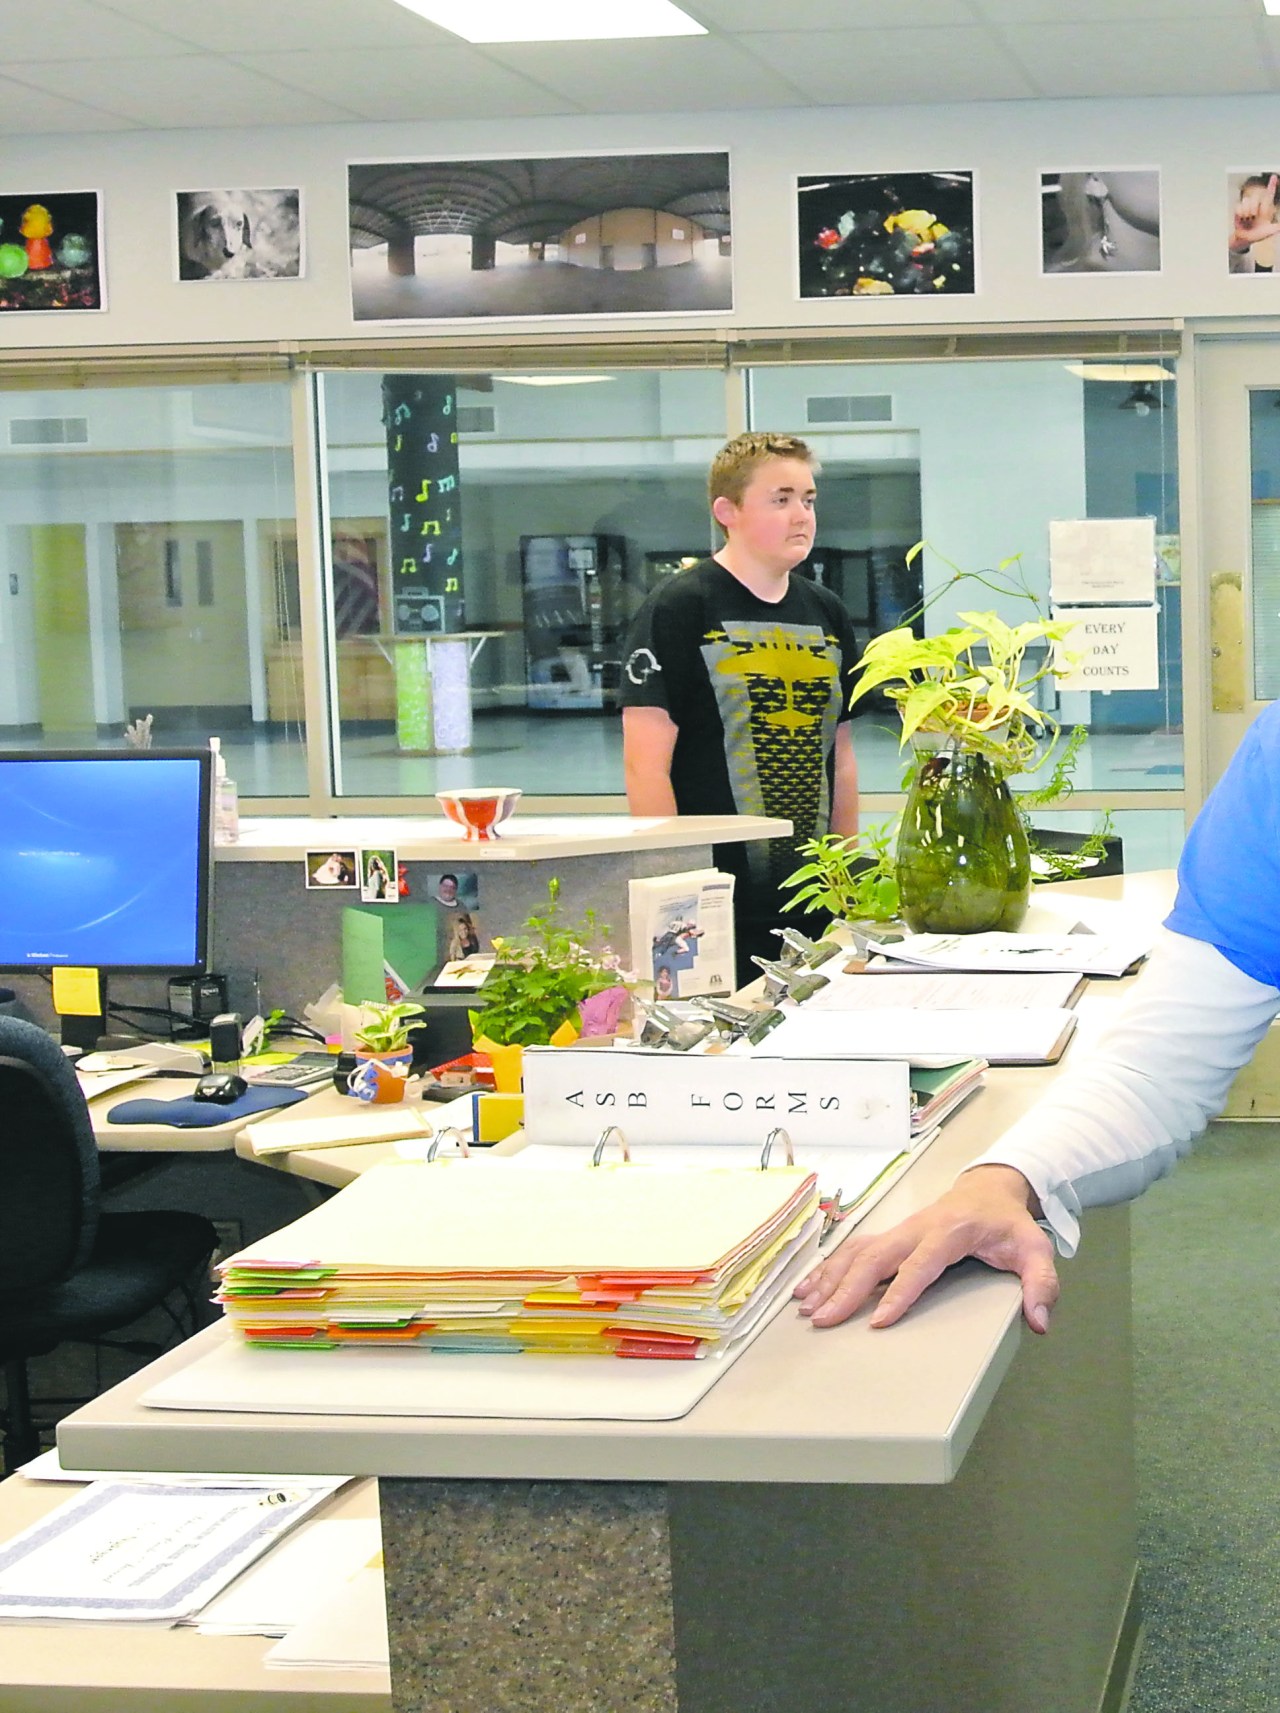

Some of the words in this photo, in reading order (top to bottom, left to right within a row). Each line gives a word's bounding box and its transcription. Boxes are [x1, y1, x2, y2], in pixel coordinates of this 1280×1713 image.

[1085, 621, 1126, 635] EVERY
[1093, 643, 1119, 655] DAY
[1083, 665, 1129, 677] COUNTS
[565, 1089, 648, 1108] ASB
[691, 1090, 840, 1114] FORMS
